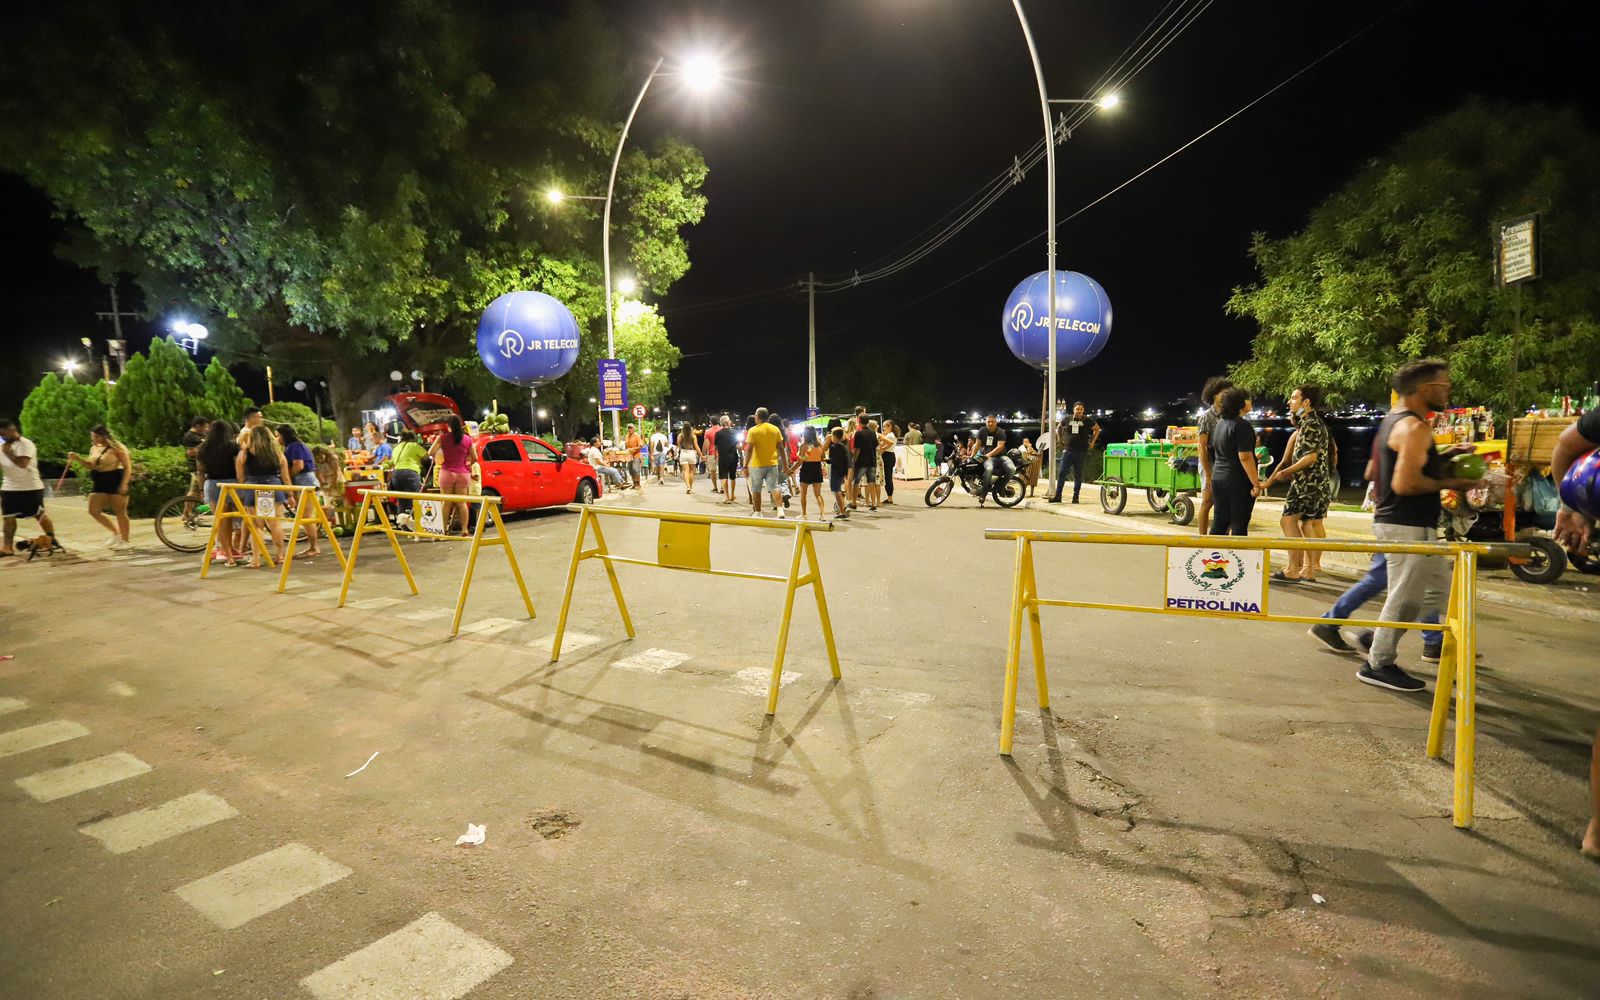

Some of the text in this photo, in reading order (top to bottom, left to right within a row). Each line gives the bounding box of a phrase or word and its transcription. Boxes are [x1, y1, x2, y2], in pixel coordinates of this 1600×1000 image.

[1055, 318, 1101, 334] TELECOM
[527, 339, 542, 350] JR
[1166, 597, 1260, 613] PETROLINA
